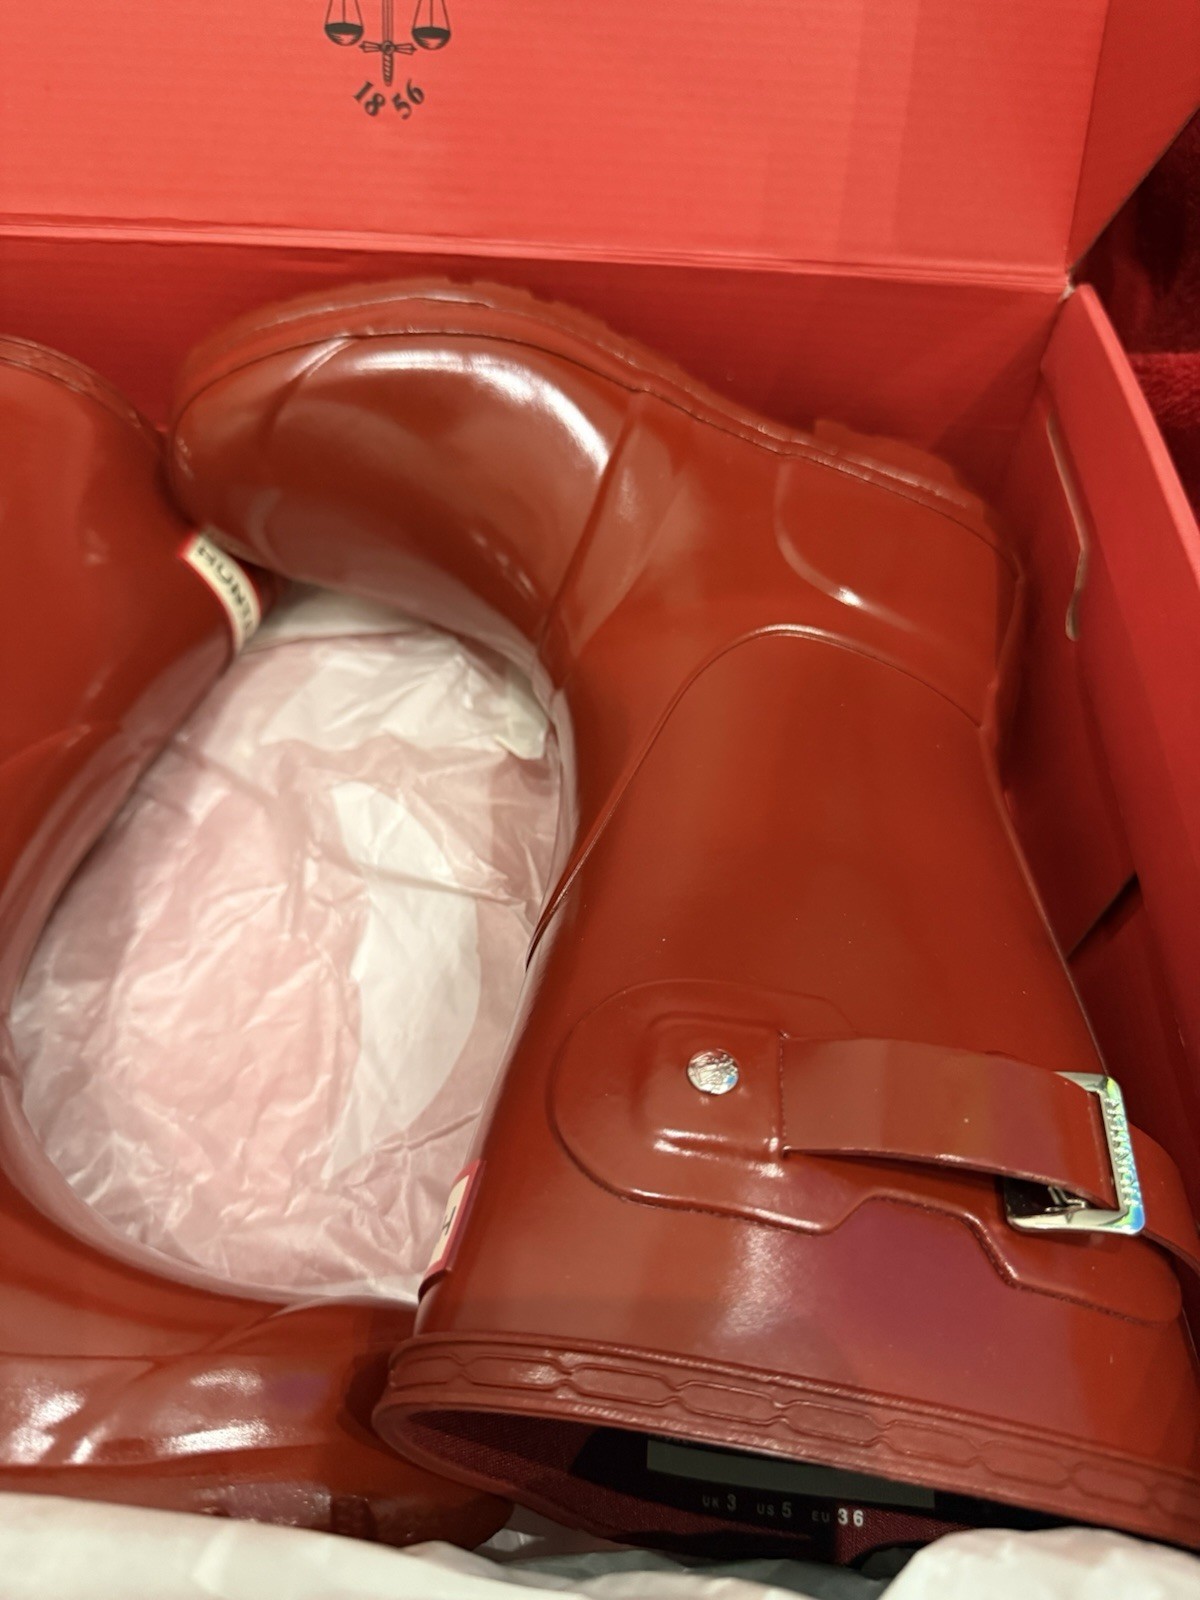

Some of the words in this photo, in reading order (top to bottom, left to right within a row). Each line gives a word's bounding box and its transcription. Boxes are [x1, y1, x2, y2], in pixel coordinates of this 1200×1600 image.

[702, 1495, 719, 1509] UK
[726, 1494, 737, 1511] 3
[756, 1504, 775, 1517] US
[781, 1501, 792, 1518] 5
[811, 1510, 831, 1523] EU
[838, 1507, 864, 1527] 36
